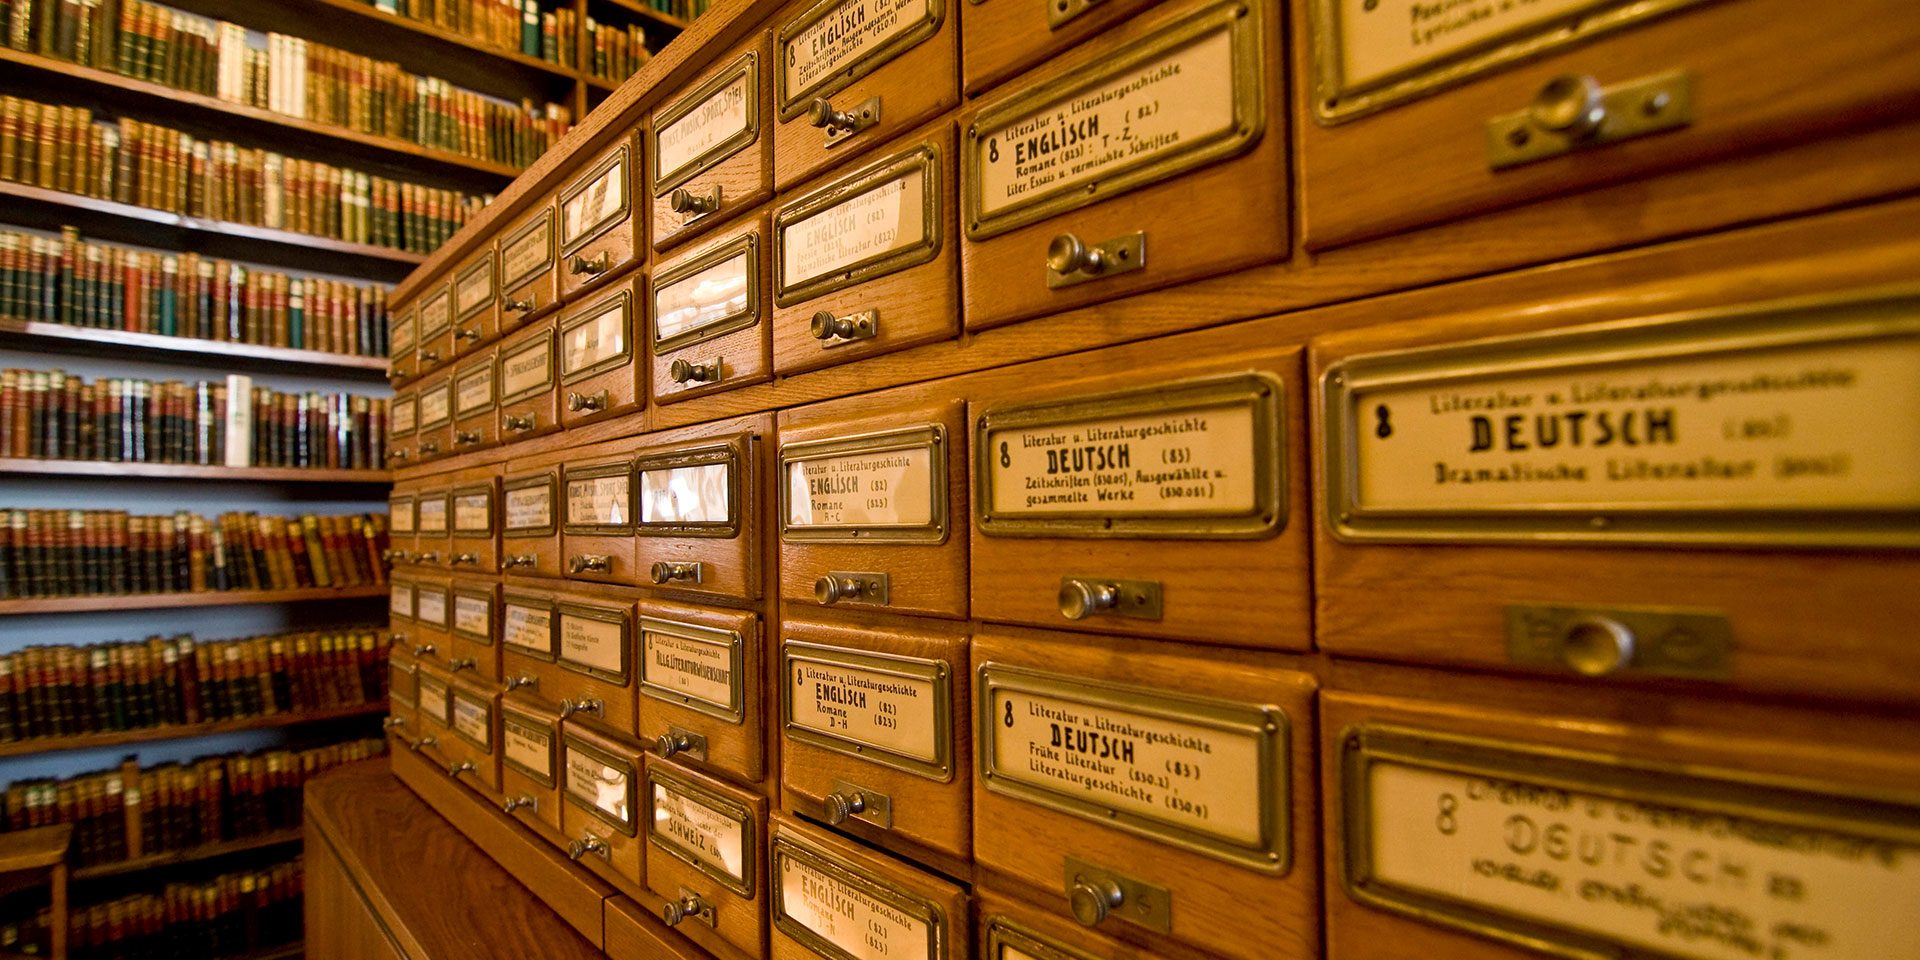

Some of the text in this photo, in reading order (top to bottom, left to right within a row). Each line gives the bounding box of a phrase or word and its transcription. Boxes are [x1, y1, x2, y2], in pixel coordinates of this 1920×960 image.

[798, 21, 826, 46] Literatur
[789, 45, 796, 67] 8
[799, 37, 864, 86] Literaturgeschichte
[1005, 116, 1051, 142] Literatur
[1071, 63, 1181, 115] Literaturgeschichte
[988, 137, 1000, 164] 8
[1030, 174, 1055, 190] Essais
[1071, 149, 1125, 175] vermischte
[1129, 130, 1180, 156] Schriften
[1016, 156, 1056, 179] Romane
[839, 240, 871, 259] Literatur
[1023, 433, 1067, 448] Literatur
[1087, 418, 1208, 443] Literaturgeschichte
[1375, 404, 1392, 440] 8
[1469, 408, 1678, 453] DEUTSCH
[803, 464, 828, 475] iteratur
[840, 456, 911, 473] Literaturgeschichte
[999, 441, 1011, 469] 8
[1046, 443, 1191, 474] DEUTSCH (83)
[871, 479, 888, 493] (82)
[1025, 474, 1090, 490] Zeitschriften
[1135, 467, 1209, 485] Ausgewählte
[1433, 460, 1590, 485] Dramatische
[811, 498, 888, 512] Romane (823)
[1026, 491, 1088, 508] gesammelte
[1096, 489, 1135, 502] Werke
[797, 667, 803, 687] 8
[806, 666, 837, 682] Literatur
[847, 675, 918, 698] Literaturgeschichte
[816, 701, 897, 730] Romane (823)
[878, 701, 897, 716] (82)
[1004, 700, 1014, 729] 8
[1029, 702, 1079, 725] Literatur
[1095, 716, 1212, 755] Literaturgeschichte
[1029, 742, 1060, 762] Frühe
[1065, 752, 1116, 775] Literatur
[1050, 723, 1201, 780] DEUTSCH (83)
[1029, 758, 1154, 804] Literaturgeschichte
[1435, 792, 1458, 836] 8
[1502, 812, 1752, 892] DEUTSCH
[795, 860, 825, 882] Literatur
[838, 881, 912, 931] Literaturgeschichte
[802, 894, 888, 956] Romane (823)
[868, 918, 888, 939] (82)
